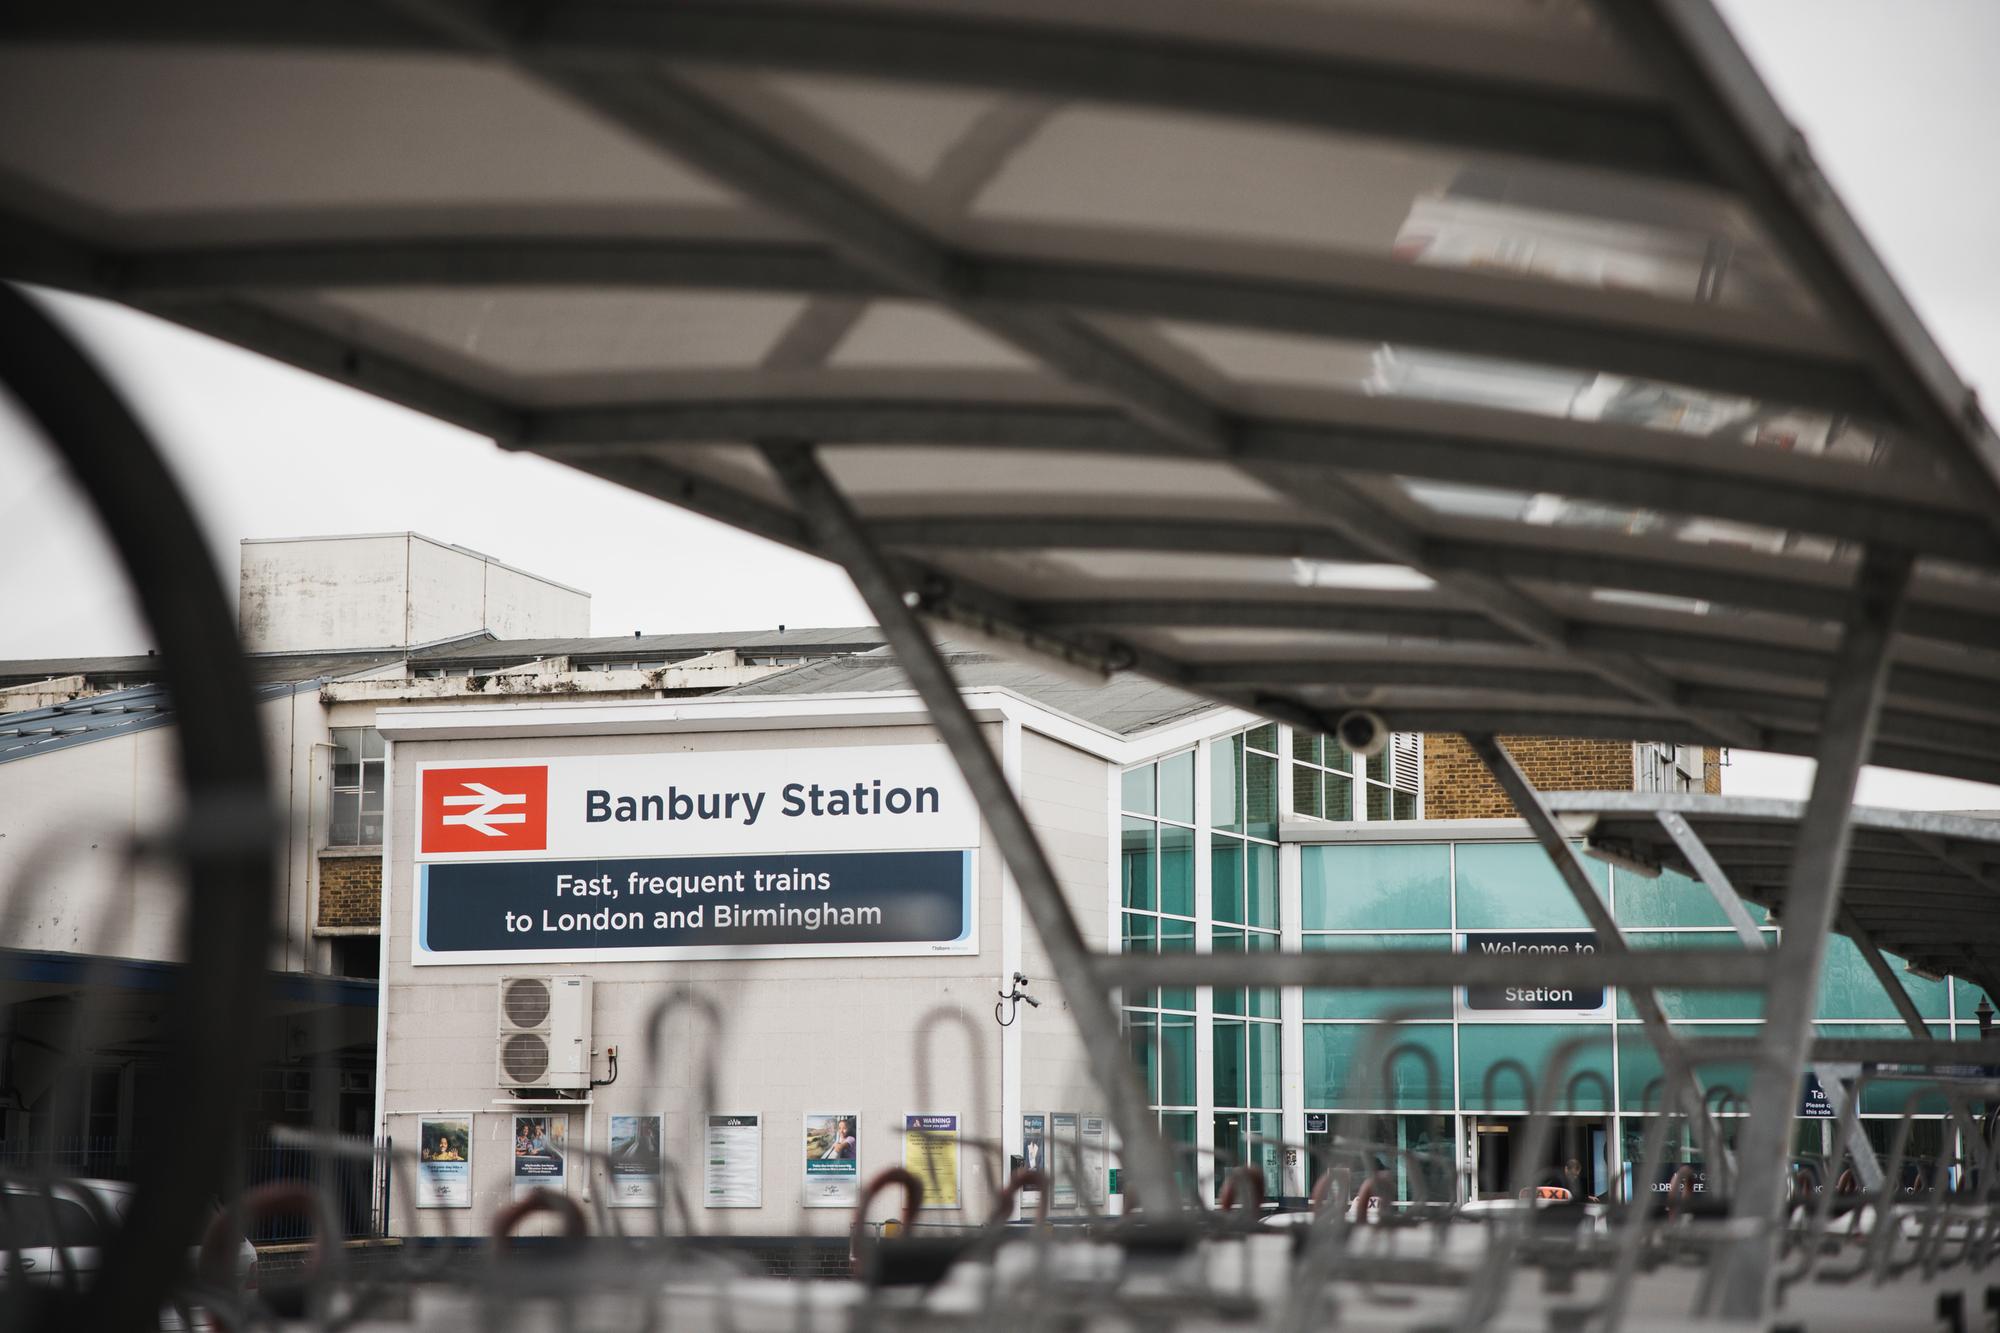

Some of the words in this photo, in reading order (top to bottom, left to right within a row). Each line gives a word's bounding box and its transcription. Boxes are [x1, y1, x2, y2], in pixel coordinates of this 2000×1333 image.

[586, 785, 766, 826] Banbury
[781, 779, 939, 817] Station
[556, 873, 619, 900] Fast,
[627, 870, 745, 899] frequent
[753, 868, 831, 892] trains
[504, 911, 533, 933] to
[542, 906, 644, 932] London
[653, 905, 704, 930] and
[713, 901, 882, 931] Birmingham
[1481, 941, 1569, 955] Welcome
[1575, 942, 1595, 955] to
[1505, 986, 1573, 1002] Station
[1530, 1189, 1566, 1200] AXI
[1659, 1183, 1684, 1191] DRP
